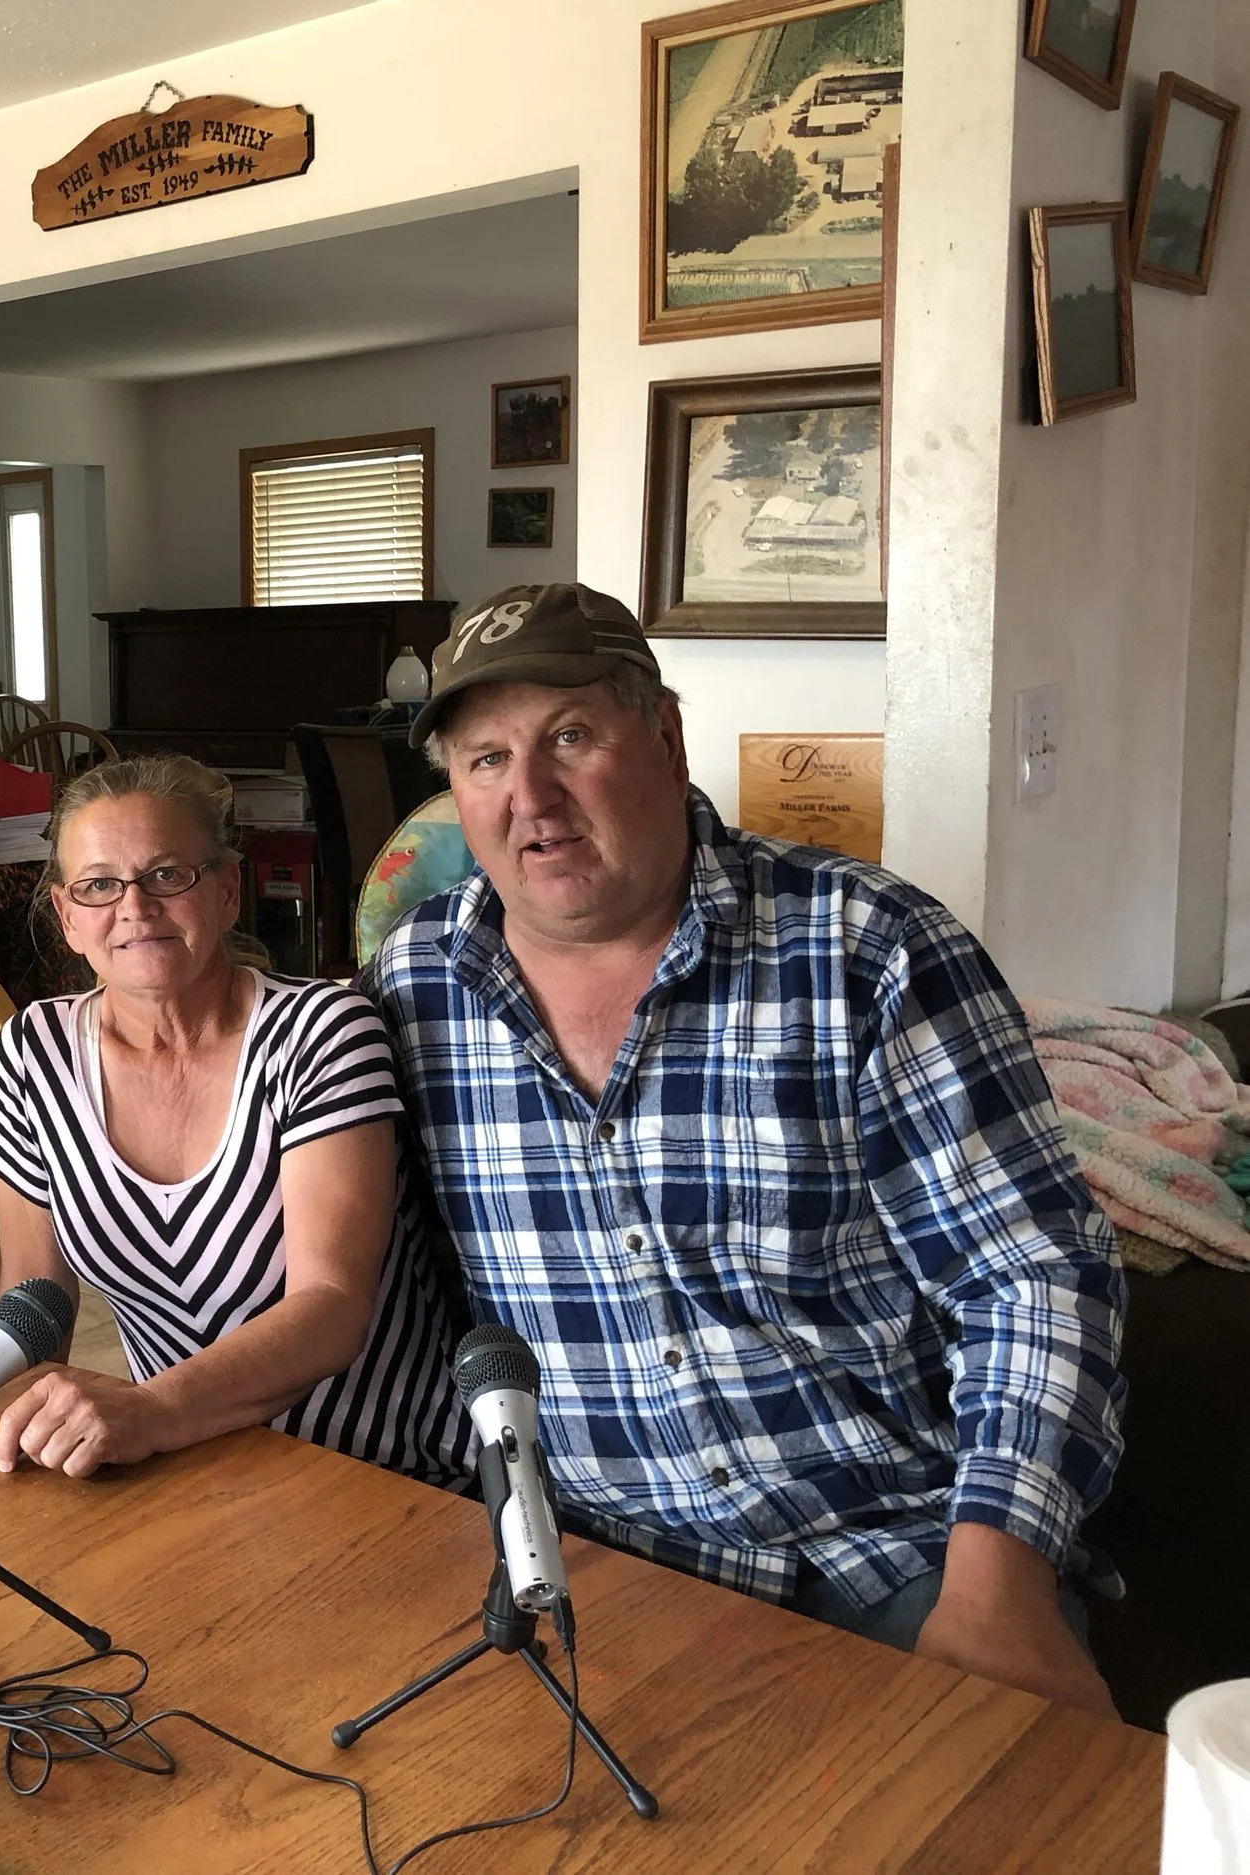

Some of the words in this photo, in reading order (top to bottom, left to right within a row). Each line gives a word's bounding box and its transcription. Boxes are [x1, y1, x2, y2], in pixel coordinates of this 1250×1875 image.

[57, 163, 94, 200] THE
[97, 119, 192, 176] MILLER
[201, 120, 274, 152] FAMILY
[121, 182, 153, 205] EST.
[162, 172, 199, 196] 1949
[451, 600, 533, 664] 78
